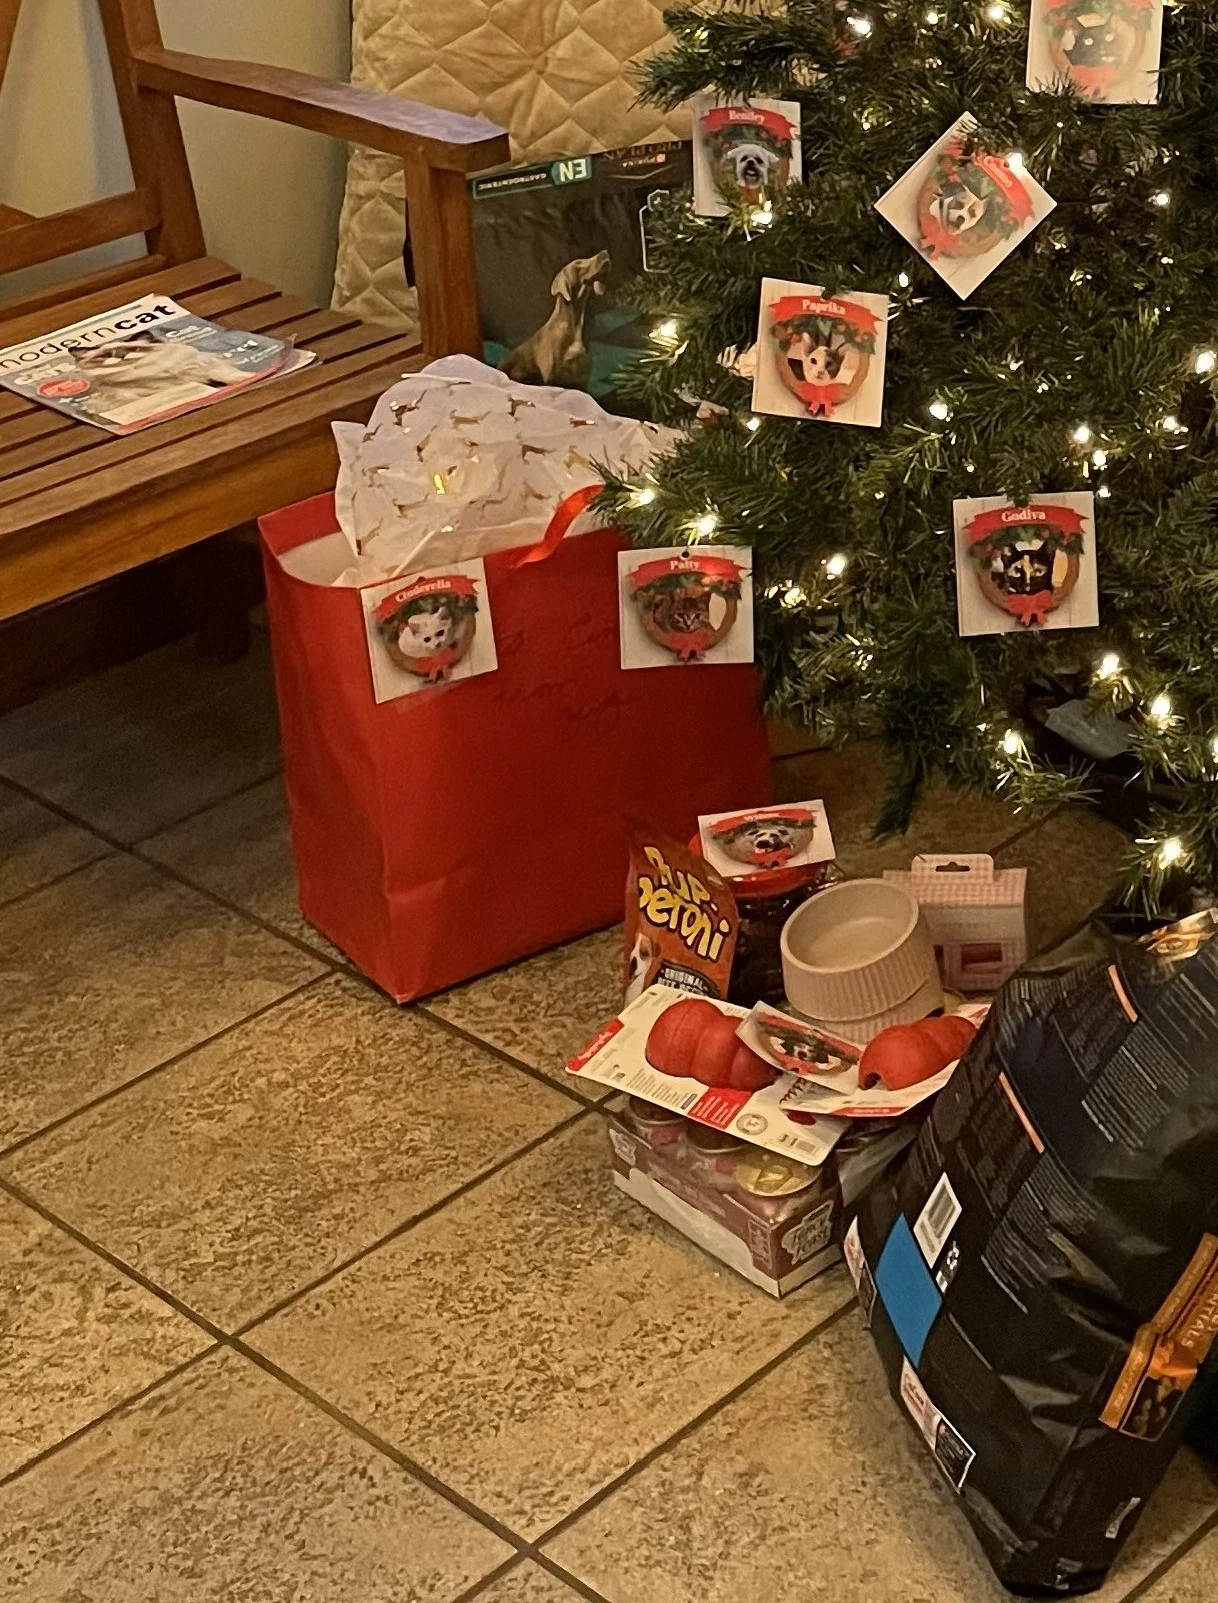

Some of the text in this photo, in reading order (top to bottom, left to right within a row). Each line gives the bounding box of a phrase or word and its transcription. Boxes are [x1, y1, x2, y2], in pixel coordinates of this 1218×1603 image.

[559, 158, 587, 182] EN
[802, 299, 846, 315] Paprika
[1002, 509, 1046, 522] Godiva
[395, 579, 452, 603] Cinderella
